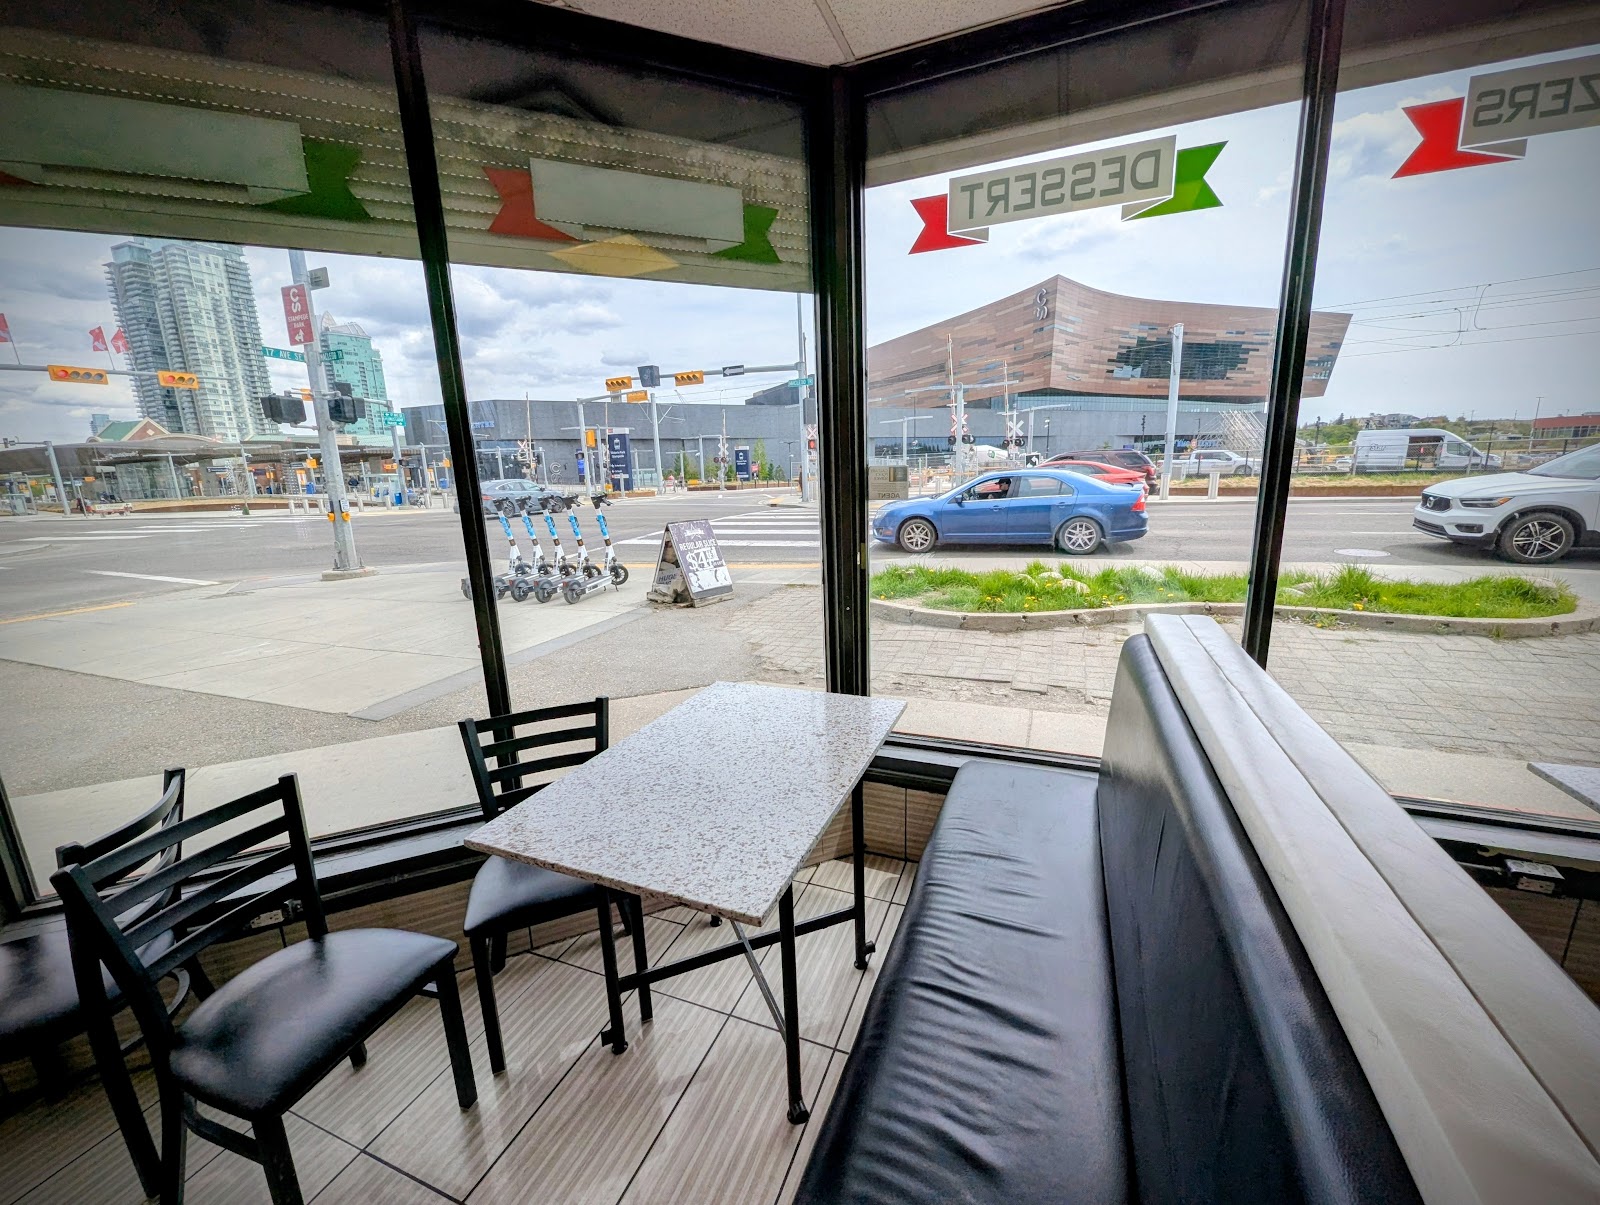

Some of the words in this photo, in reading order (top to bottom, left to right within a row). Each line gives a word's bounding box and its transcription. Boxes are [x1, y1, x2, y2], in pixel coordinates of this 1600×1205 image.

[288, 313, 309, 322] STAMPEDE
[280, 351, 291, 359] AVE
[679, 541, 703, 551] REGULAR
[703, 539, 717, 547] SLICE
